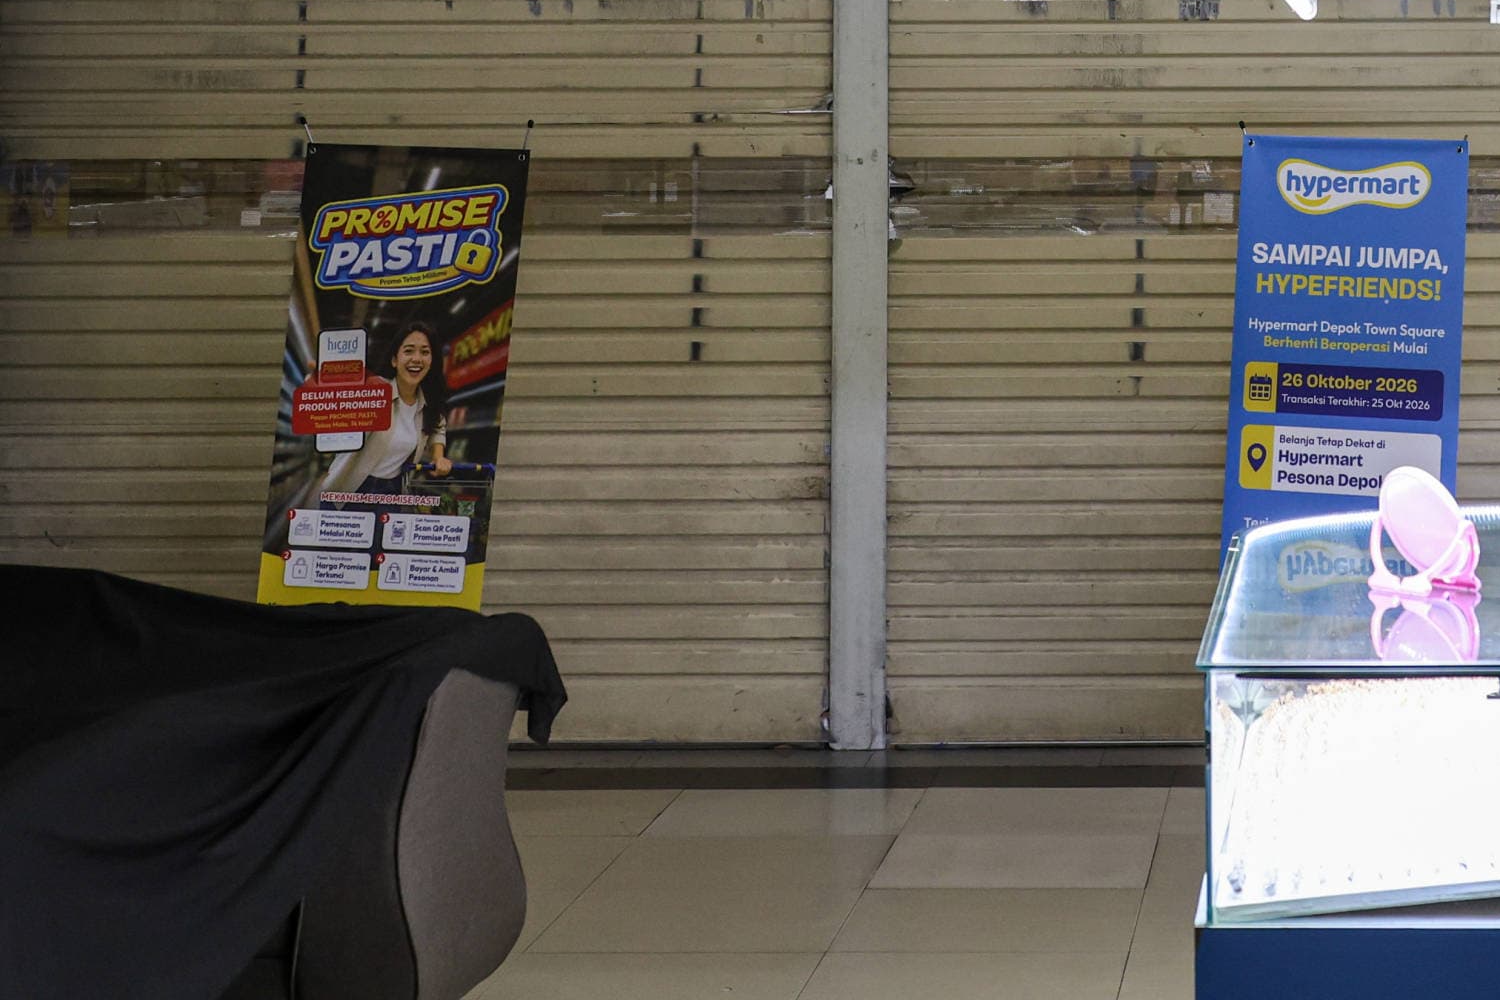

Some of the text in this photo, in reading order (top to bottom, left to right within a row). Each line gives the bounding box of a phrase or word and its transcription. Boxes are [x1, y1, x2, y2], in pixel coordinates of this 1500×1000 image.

[1285, 169, 1421, 198] hypermart
[318, 195, 496, 239] PROMISE
[325, 233, 458, 276] PASTI
[1252, 242, 1449, 275] SAMPAI JUMPA,
[1255, 272, 1442, 301] HYPEFRIENDS!
[1248, 317, 1446, 340] Hypermart Depok Town Square
[327, 336, 359, 351] hicard
[1263, 335, 1429, 355] Berhenti Beroperasi Mulai
[1281, 372, 1418, 394] 26 Oktober 2026
[301, 388, 385, 401] BELUM KEBAGIAN
[1281, 393, 1431, 411] Transaksi Terakhir: 25 Okt 2026
[298, 399, 387, 412] PRODUK PROMISE?
[1279, 434, 1386, 449] Belanja Tetap Dekat di
[1278, 449, 1364, 467] Hypermart
[1277, 469, 1335, 486] Pesona
[321, 491, 375, 503] MEKANISME
[375, 493, 415, 505] PROMISE
[415, 495, 441, 506] PASTI
[320, 520, 361, 529] Pemesanan
[414, 524, 464, 534] Scan QR Code
[319, 530, 364, 539] Melalui Kasir
[413, 533, 461, 543] Promise Pasti
[316, 561, 367, 571] Harga Promise
[409, 564, 432, 574] Bayar
[438, 566, 460, 574] Ambil
[315, 570, 344, 580] Terkunci
[408, 573, 439, 583] Pesanan
